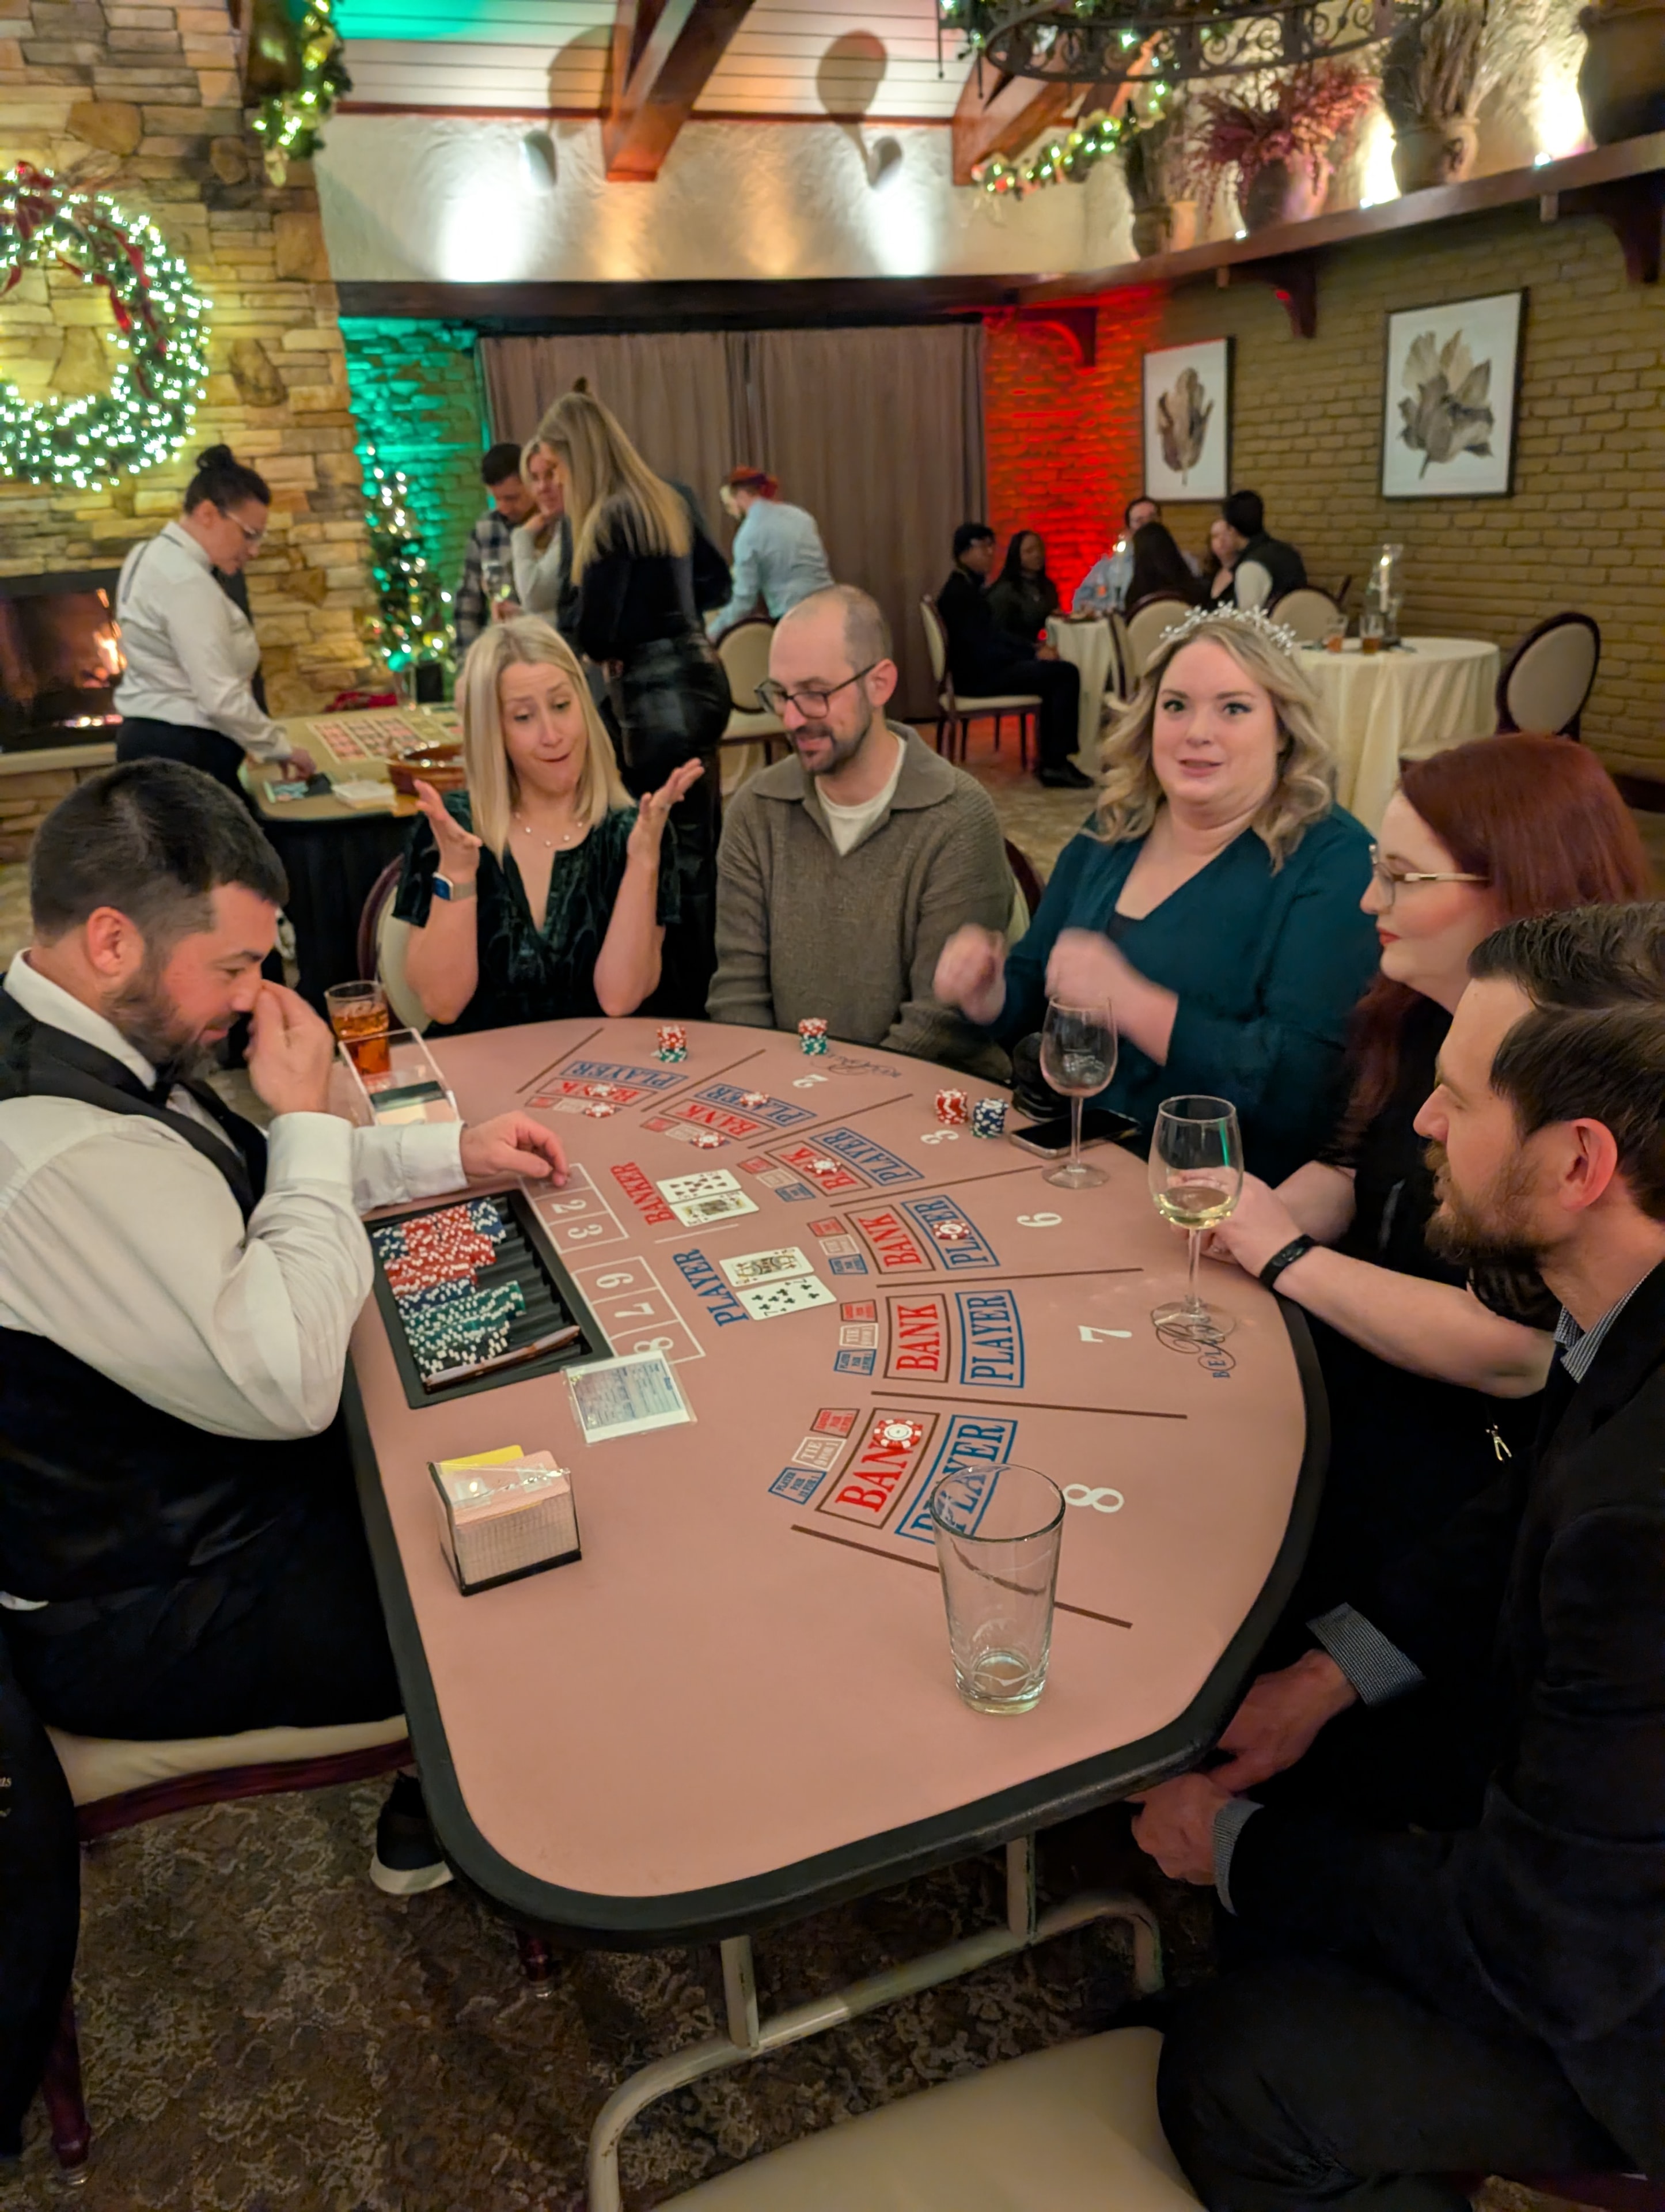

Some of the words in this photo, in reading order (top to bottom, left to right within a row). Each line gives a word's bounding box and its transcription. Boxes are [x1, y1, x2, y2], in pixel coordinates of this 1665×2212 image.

[572, 1063, 675, 1087] PLAYER
[555, 1081, 640, 1103] BK
[706, 1086, 805, 1122] PLER
[675, 1104, 761, 1135] BANK
[921, 1130, 958, 1145] 3
[780, 1147, 858, 1190] BK
[824, 1131, 913, 1181] PLAYER
[552, 1199, 587, 1214] 2
[610, 1162, 676, 1226] BANKER
[568, 1224, 603, 1239] 3
[913, 1200, 989, 1265] PLER
[1017, 1213, 1063, 1228] 6
[858, 1213, 923, 1267] BANK
[596, 1272, 634, 1289] 6
[672, 1248, 749, 1327] PLAYER
[614, 1302, 655, 1319] 7
[634, 1337, 674, 1354] 8
[896, 1304, 940, 1372] BANK
[966, 1295, 1014, 1381] PLAYER
[1078, 1325, 1132, 1343] 7
[801, 1441, 822, 1460] TIE
[835, 1424, 924, 1513] BAN
[910, 1423, 1006, 1533] PLAYER
[1063, 1483, 1125, 1513] 8
